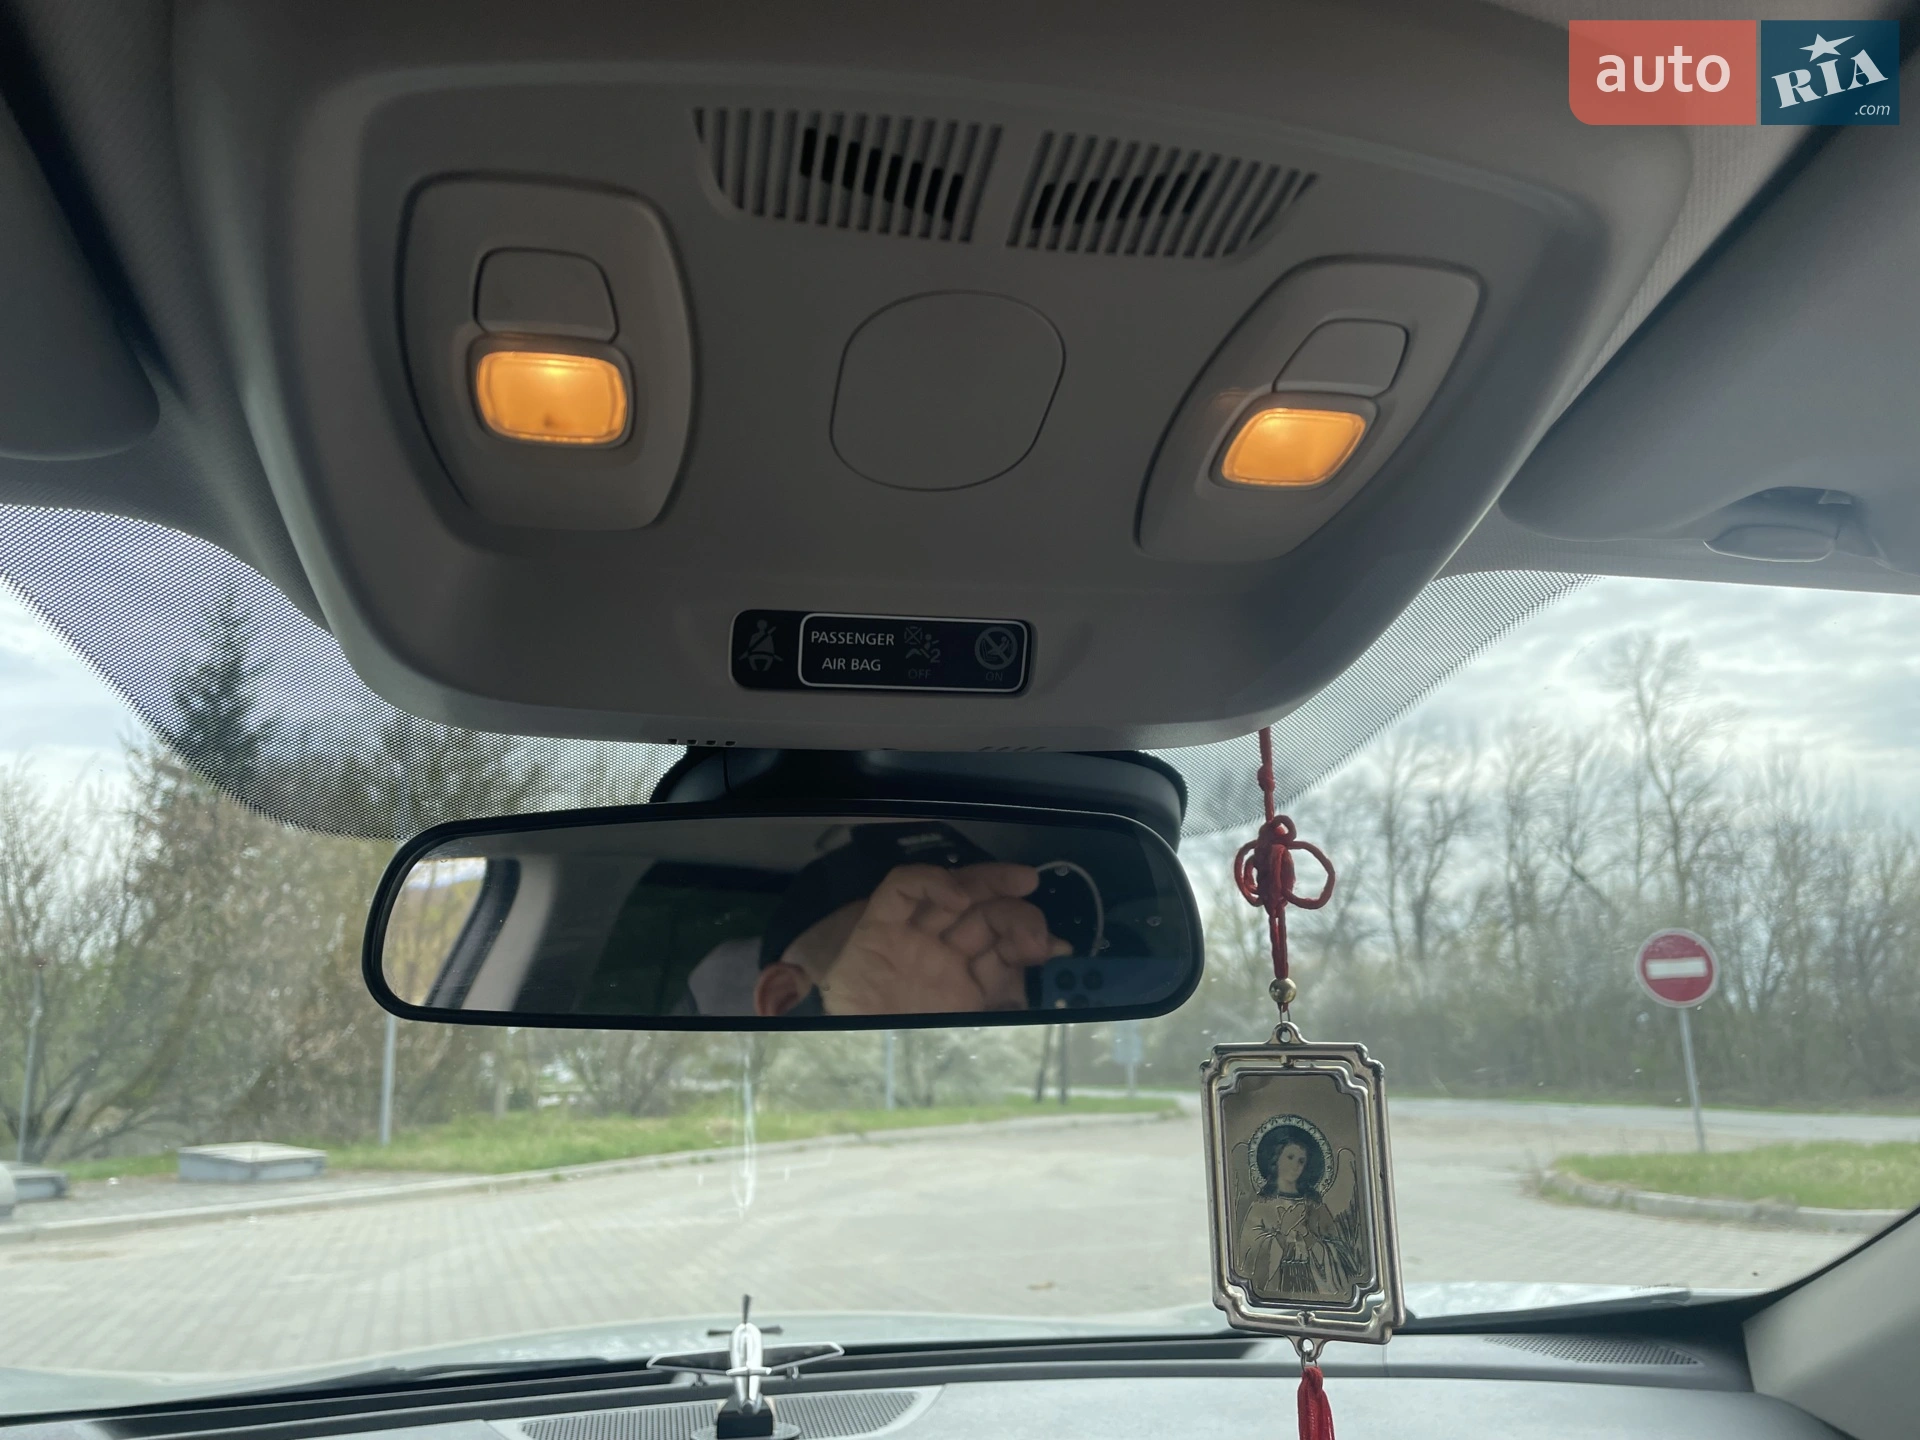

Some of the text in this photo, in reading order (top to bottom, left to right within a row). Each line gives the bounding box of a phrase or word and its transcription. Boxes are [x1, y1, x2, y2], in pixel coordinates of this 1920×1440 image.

[811, 631, 895, 646] PASSENGER
[821, 657, 881, 672] AIR BAG
[908, 668, 932, 680] OFF
[985, 671, 1004, 682] ON
